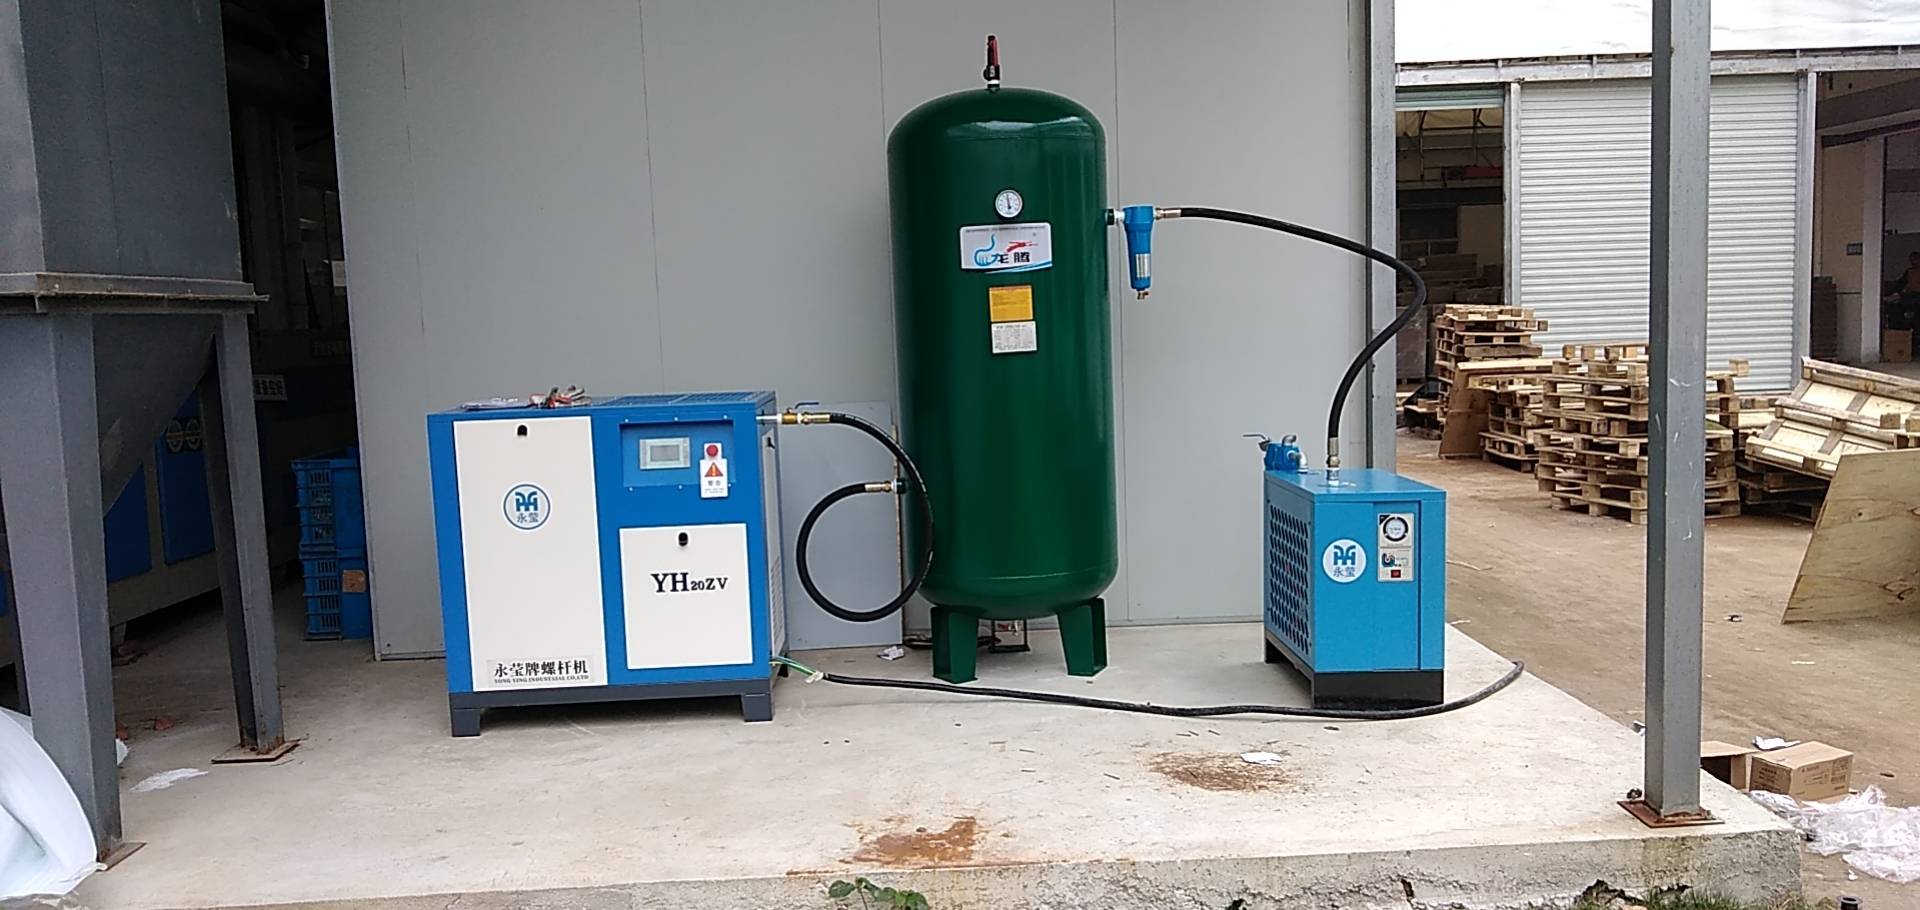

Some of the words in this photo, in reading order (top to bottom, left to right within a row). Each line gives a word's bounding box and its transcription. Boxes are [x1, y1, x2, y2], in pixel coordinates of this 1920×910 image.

[650, 572, 729, 593] YH20ZV
[494, 659, 588, 678] 永莹牌螺杆机
